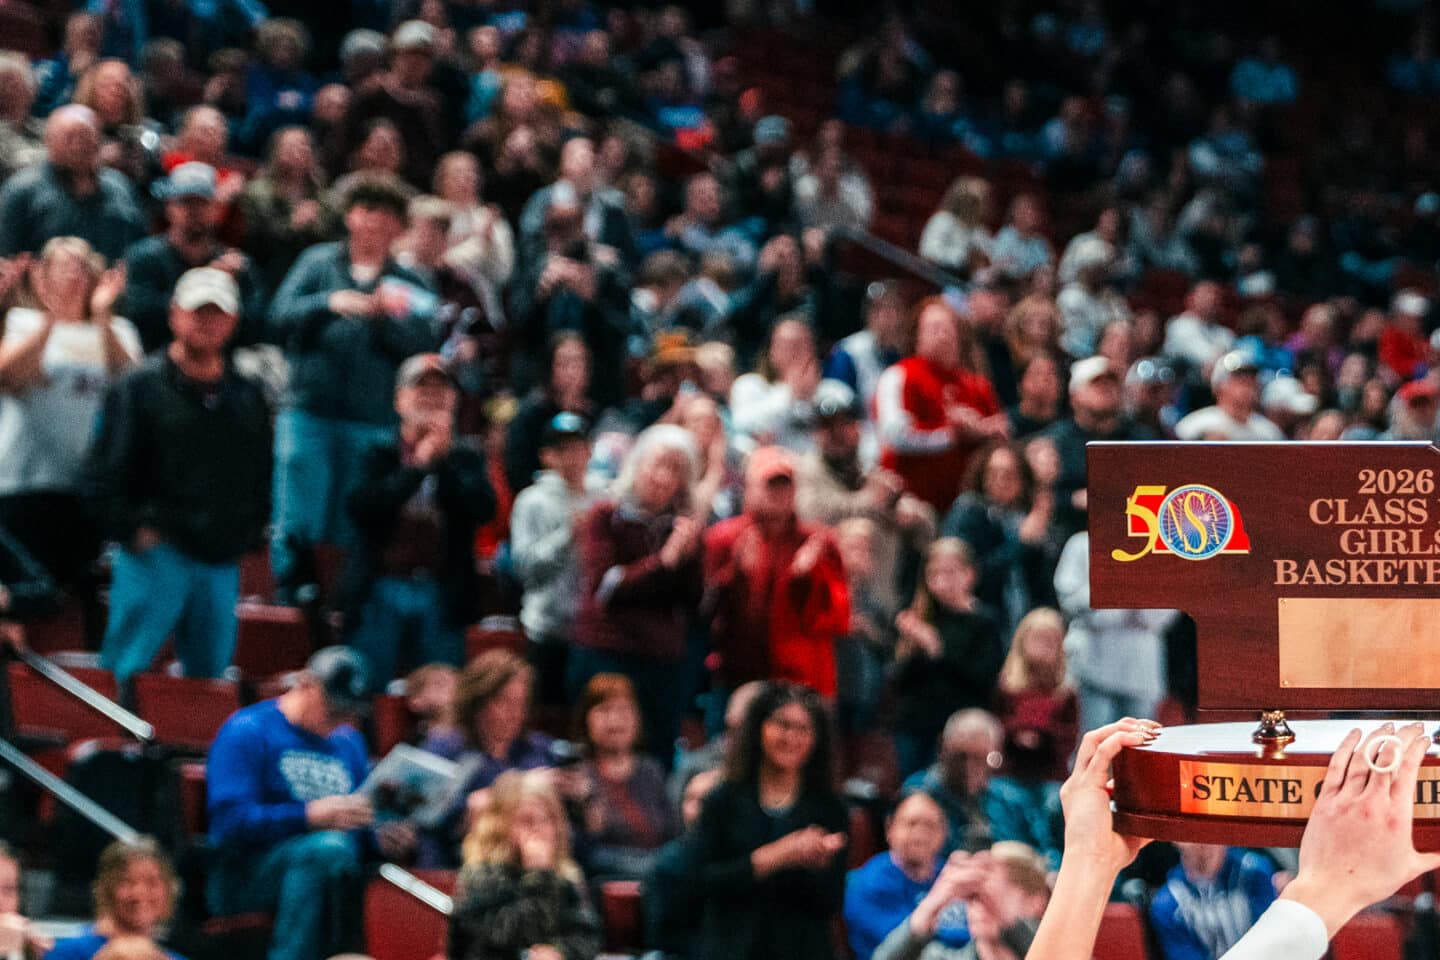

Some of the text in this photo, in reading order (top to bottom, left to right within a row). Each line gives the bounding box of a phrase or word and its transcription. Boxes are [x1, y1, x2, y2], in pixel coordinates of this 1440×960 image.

[1357, 468, 1435, 495] 2026
[1308, 498, 1429, 525] CLASS
[1191, 774, 1303, 804] STATE
